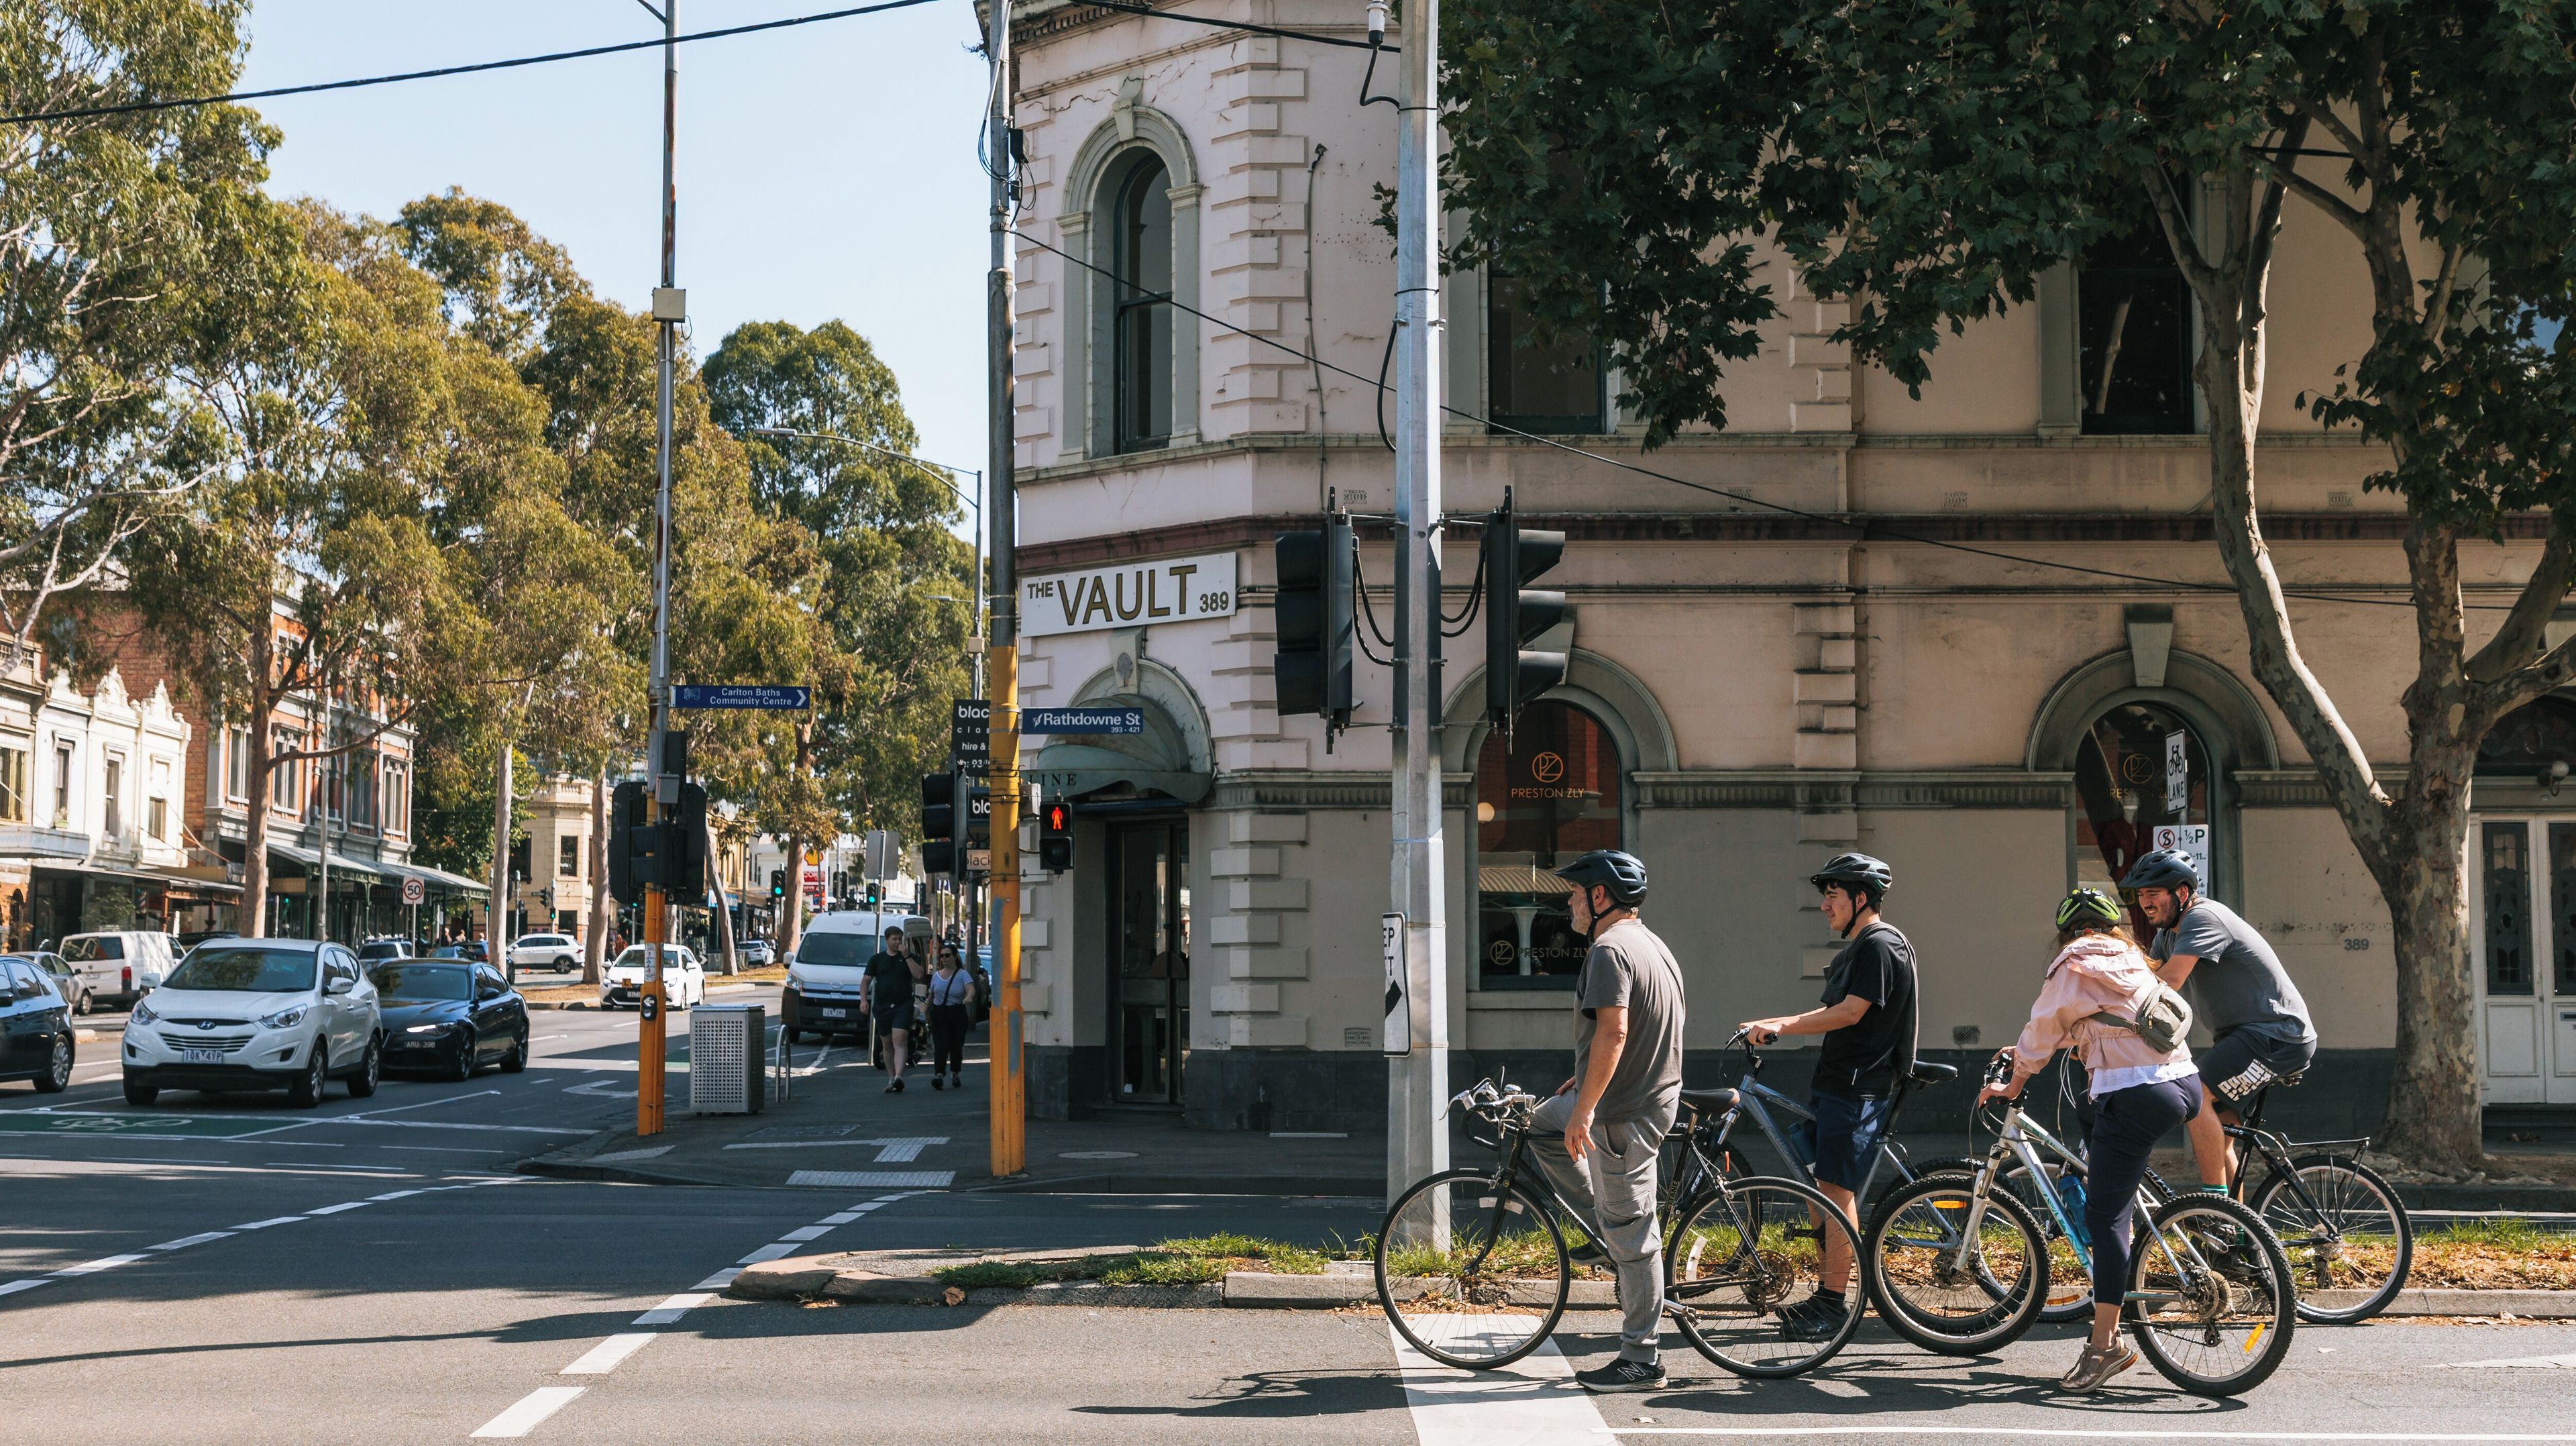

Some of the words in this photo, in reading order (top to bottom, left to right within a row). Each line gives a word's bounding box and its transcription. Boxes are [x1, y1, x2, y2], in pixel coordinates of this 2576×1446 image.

[1027, 581, 1053, 599] THE
[1057, 564, 1197, 626] VAULT
[1199, 590, 1230, 613] 389
[721, 688, 753, 696] Carlton
[756, 688, 781, 696] Baths
[710, 696, 761, 707] Community
[763, 697, 792, 705] Centre
[1043, 713, 1122, 725] Rathdowne
[1126, 713, 1140, 725] St
[961, 742, 978, 750] hire
[979, 742, 986, 750] &
[1511, 788, 1564, 798] PRESTON
[1567, 788, 1585, 798] ZLY
[2168, 781, 2184, 802] LANE
[407, 885, 421, 896] 50
[2344, 939, 2369, 951] 389
[1517, 947, 1570, 958] PRESTON
